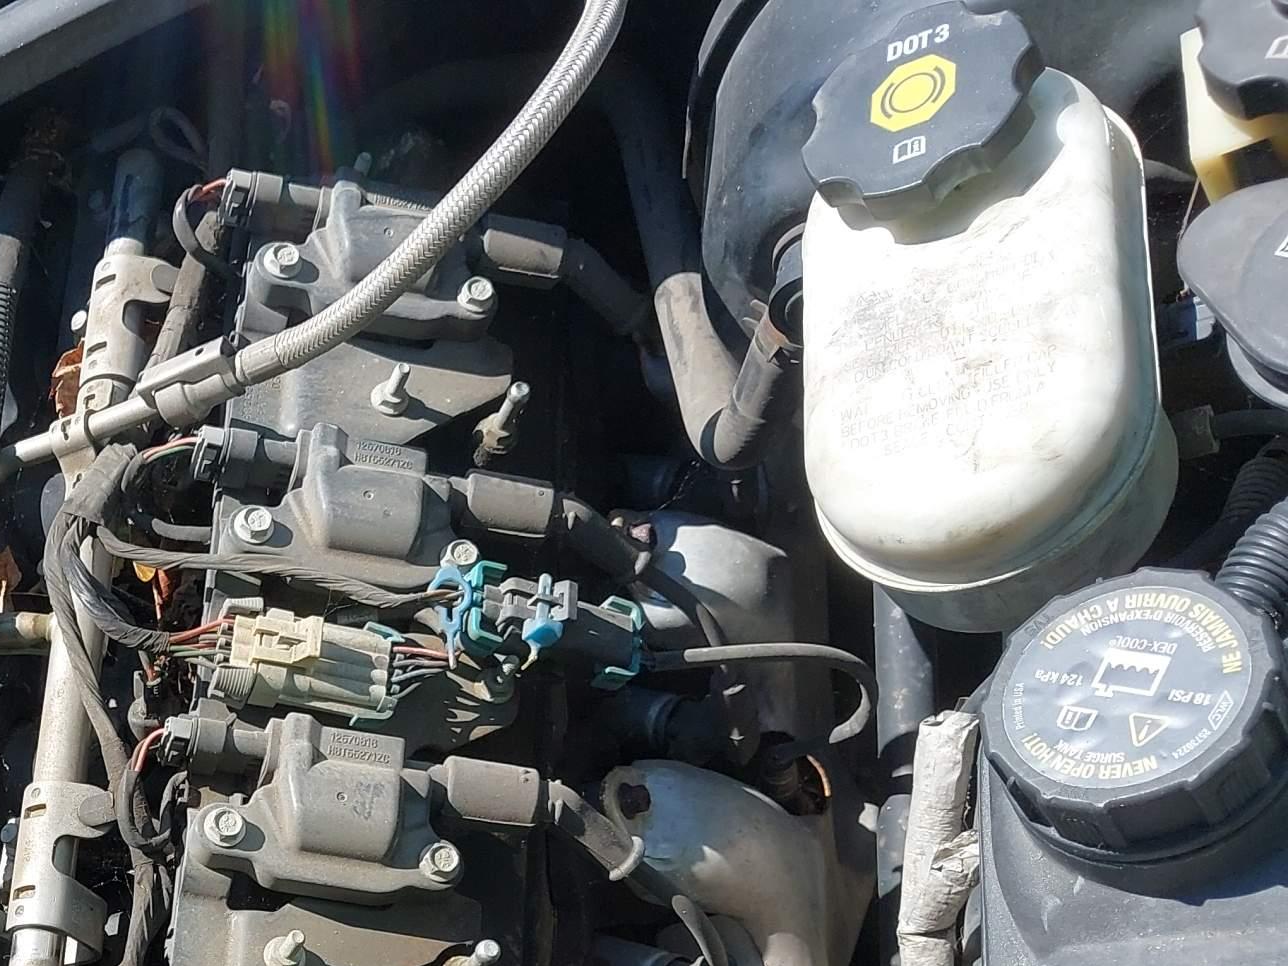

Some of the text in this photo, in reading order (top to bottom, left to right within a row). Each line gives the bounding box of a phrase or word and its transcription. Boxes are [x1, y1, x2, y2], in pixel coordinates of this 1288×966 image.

[887, 23, 950, 62] DOT 3
[1125, 593, 1191, 613] OUVRIR
[1040, 606, 1103, 650] CHAUD!
[1192, 602, 1238, 650] JAMAIS
[1222, 650, 1243, 674] NE
[1034, 669, 1083, 686] 124 kPa
[1167, 688, 1212, 706] 18 PSI
[1021, 732, 1158, 779] NEVER OPEN HOT!
[1052, 739, 1125, 764] SURGE TANK
